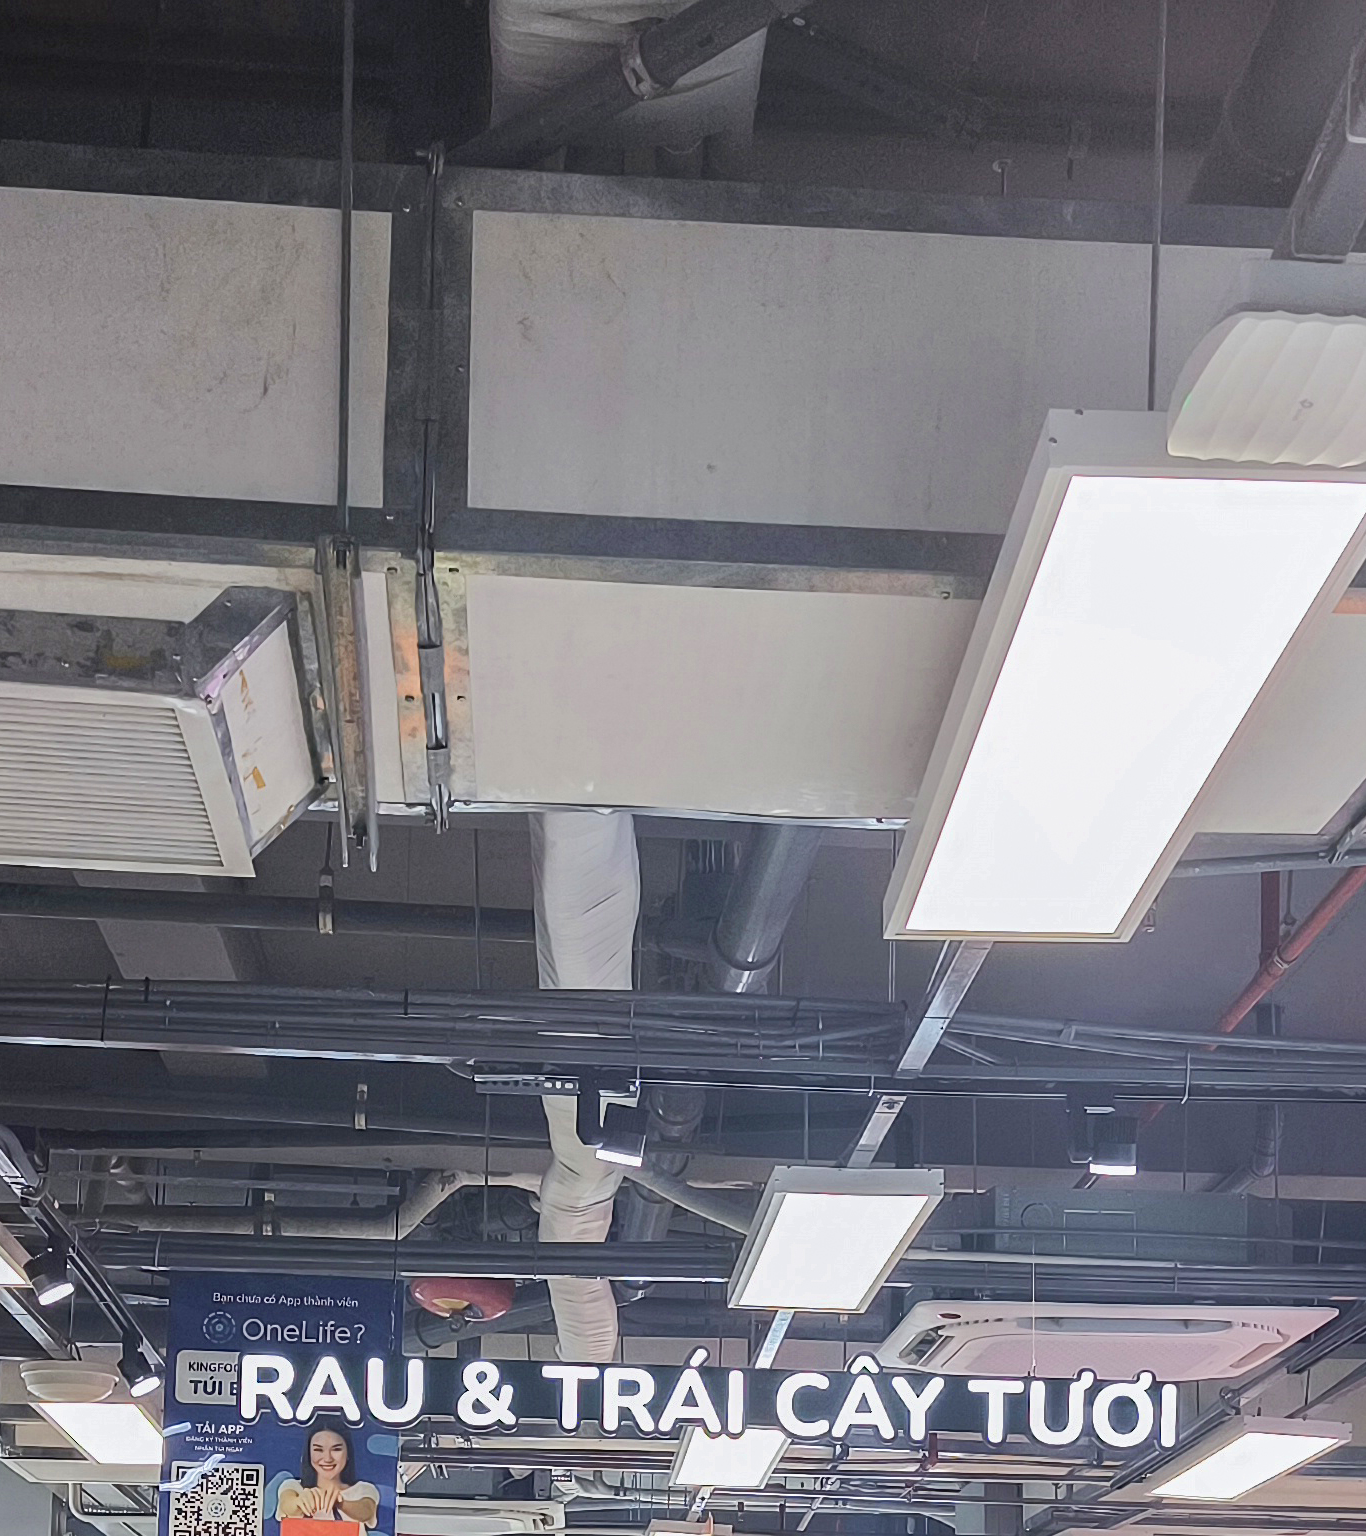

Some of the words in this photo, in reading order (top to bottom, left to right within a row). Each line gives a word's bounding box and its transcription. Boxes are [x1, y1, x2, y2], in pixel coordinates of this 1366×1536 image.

[278, 1295, 301, 1307] App
[304, 1295, 334, 1307] thành
[242, 1318, 366, 1344] OneLife?
[189, 1376, 223, 1396] TÚI
[239, 1352, 425, 1425] RAU
[456, 1361, 517, 1428] &
[541, 1347, 744, 1436] TRÁI
[776, 1355, 945, 1442] CÂY
[968, 1370, 1178, 1448] TƯƠI
[219, 1424, 245, 1435] APP
